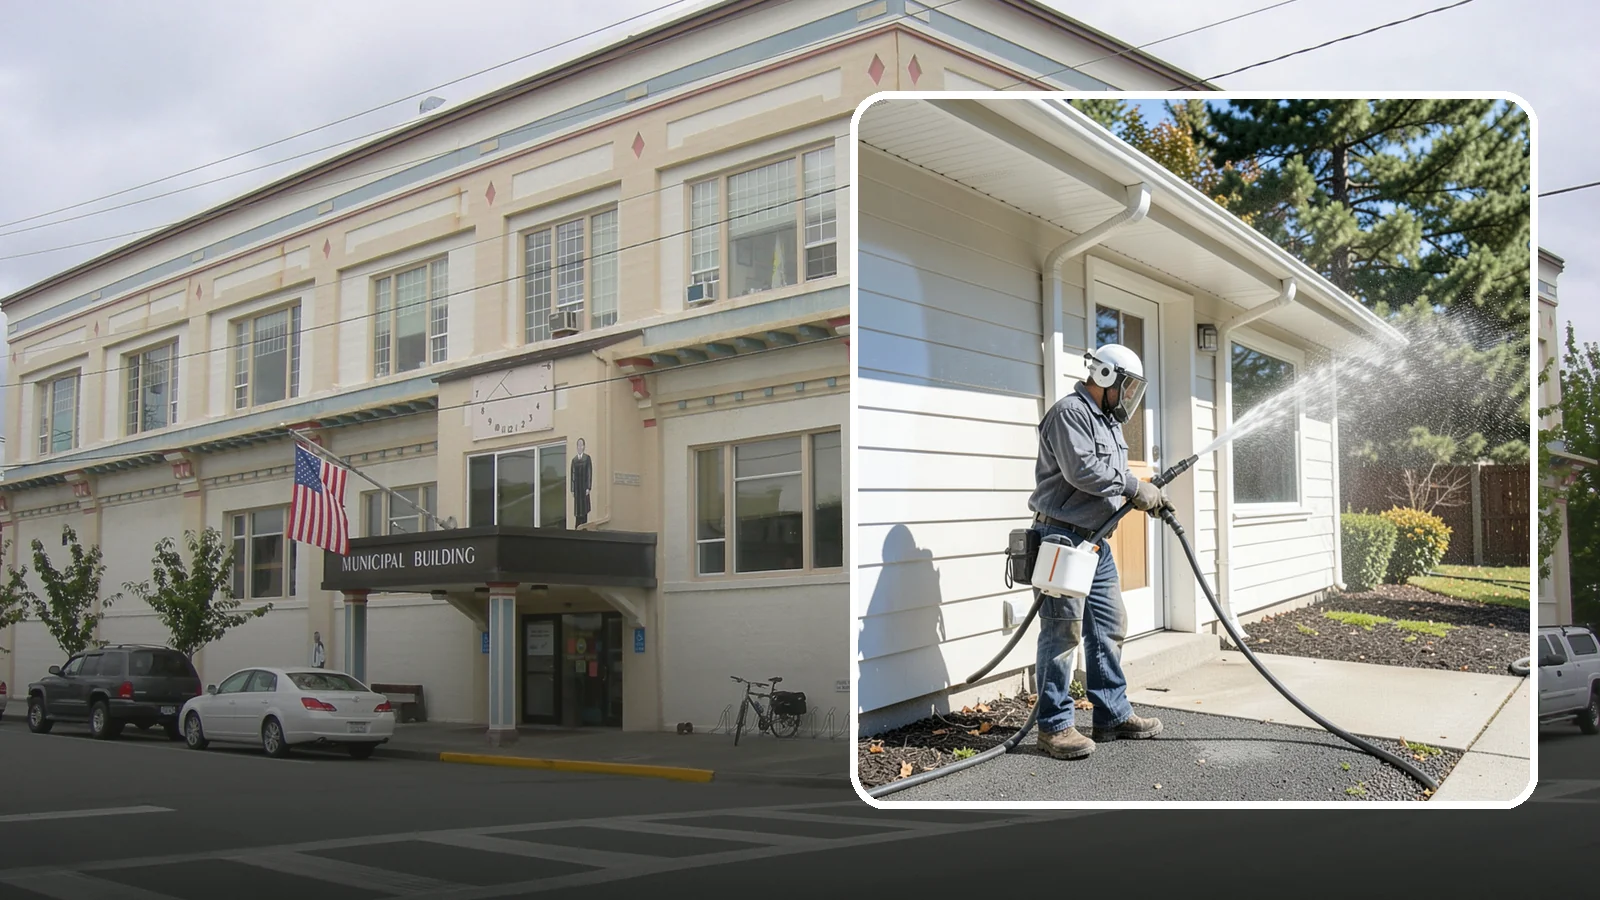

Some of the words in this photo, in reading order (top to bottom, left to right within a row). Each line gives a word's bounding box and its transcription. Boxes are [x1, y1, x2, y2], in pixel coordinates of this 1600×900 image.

[546, 362, 552, 370] 6
[488, 418, 492, 426] 9
[529, 414, 532, 422] 3
[494, 424, 500, 432] 10
[342, 552, 406, 572] MUNICIPAL
[414, 546, 475, 567] BUILDING
